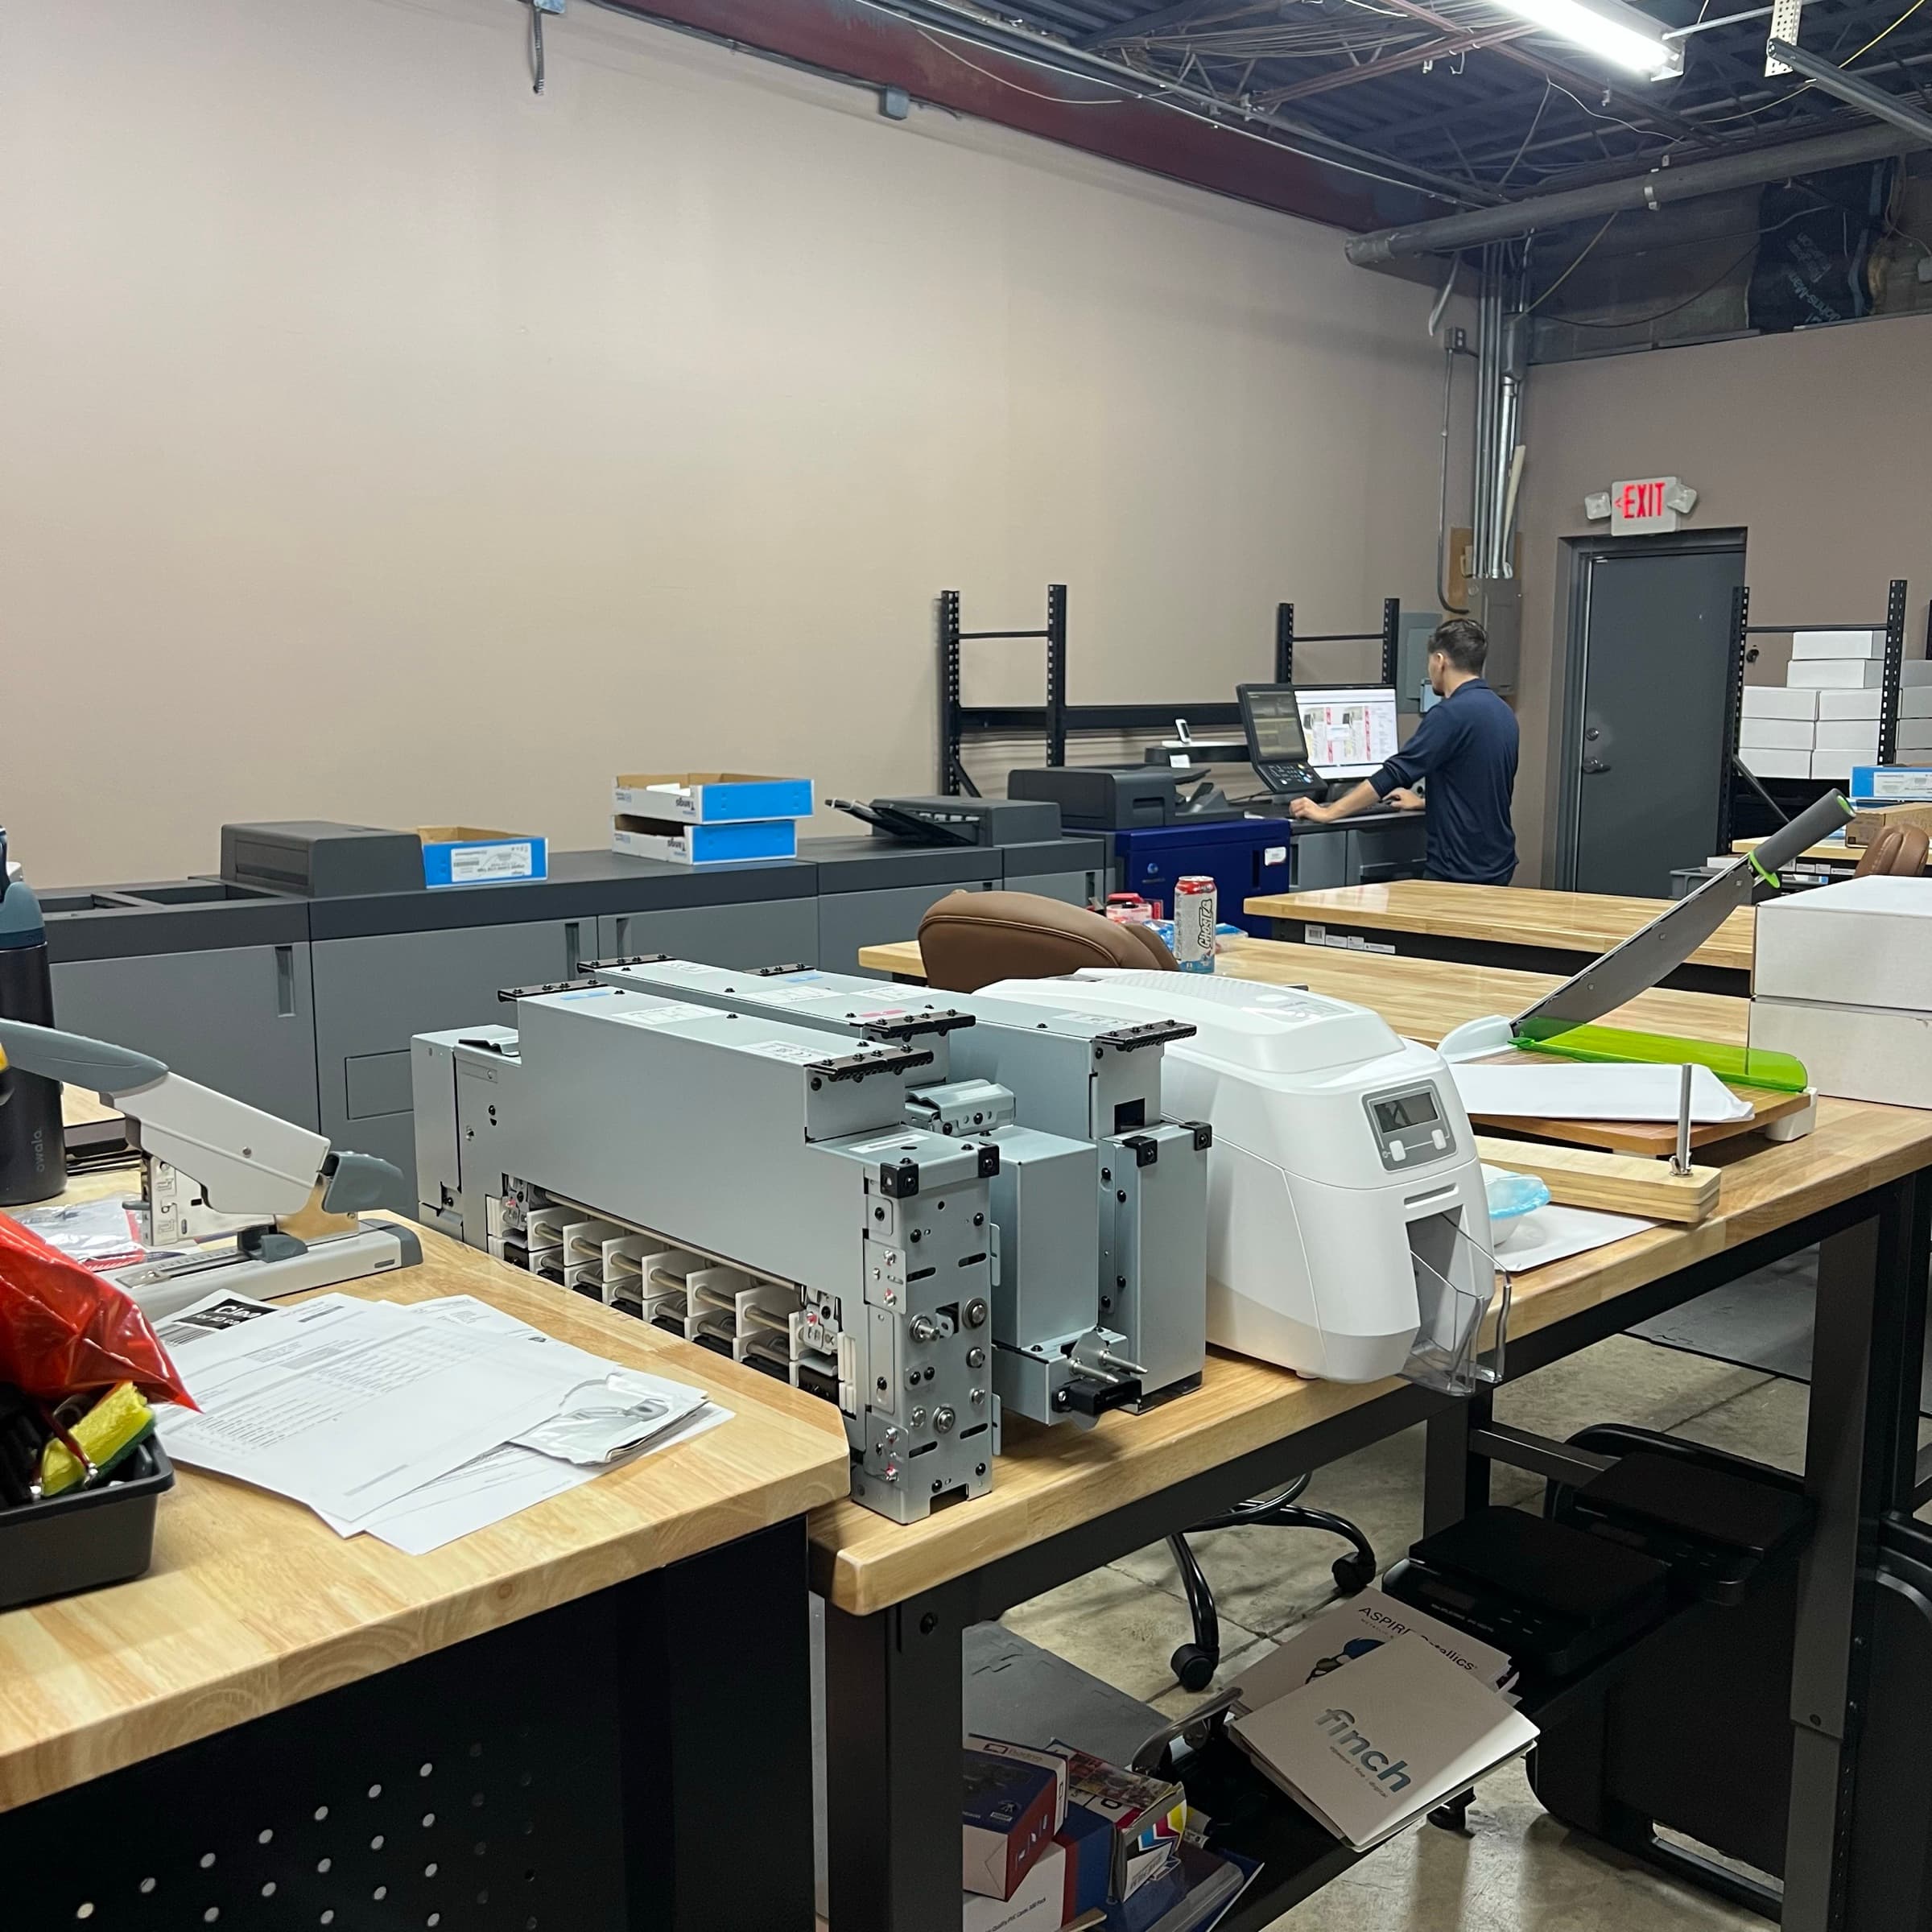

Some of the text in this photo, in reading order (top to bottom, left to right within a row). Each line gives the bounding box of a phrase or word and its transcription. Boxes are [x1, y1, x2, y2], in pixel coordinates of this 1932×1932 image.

[1624, 482, 1665, 518] EXIT
[31, 1129, 45, 1173] owala
[1315, 1707, 1411, 1794] finch
